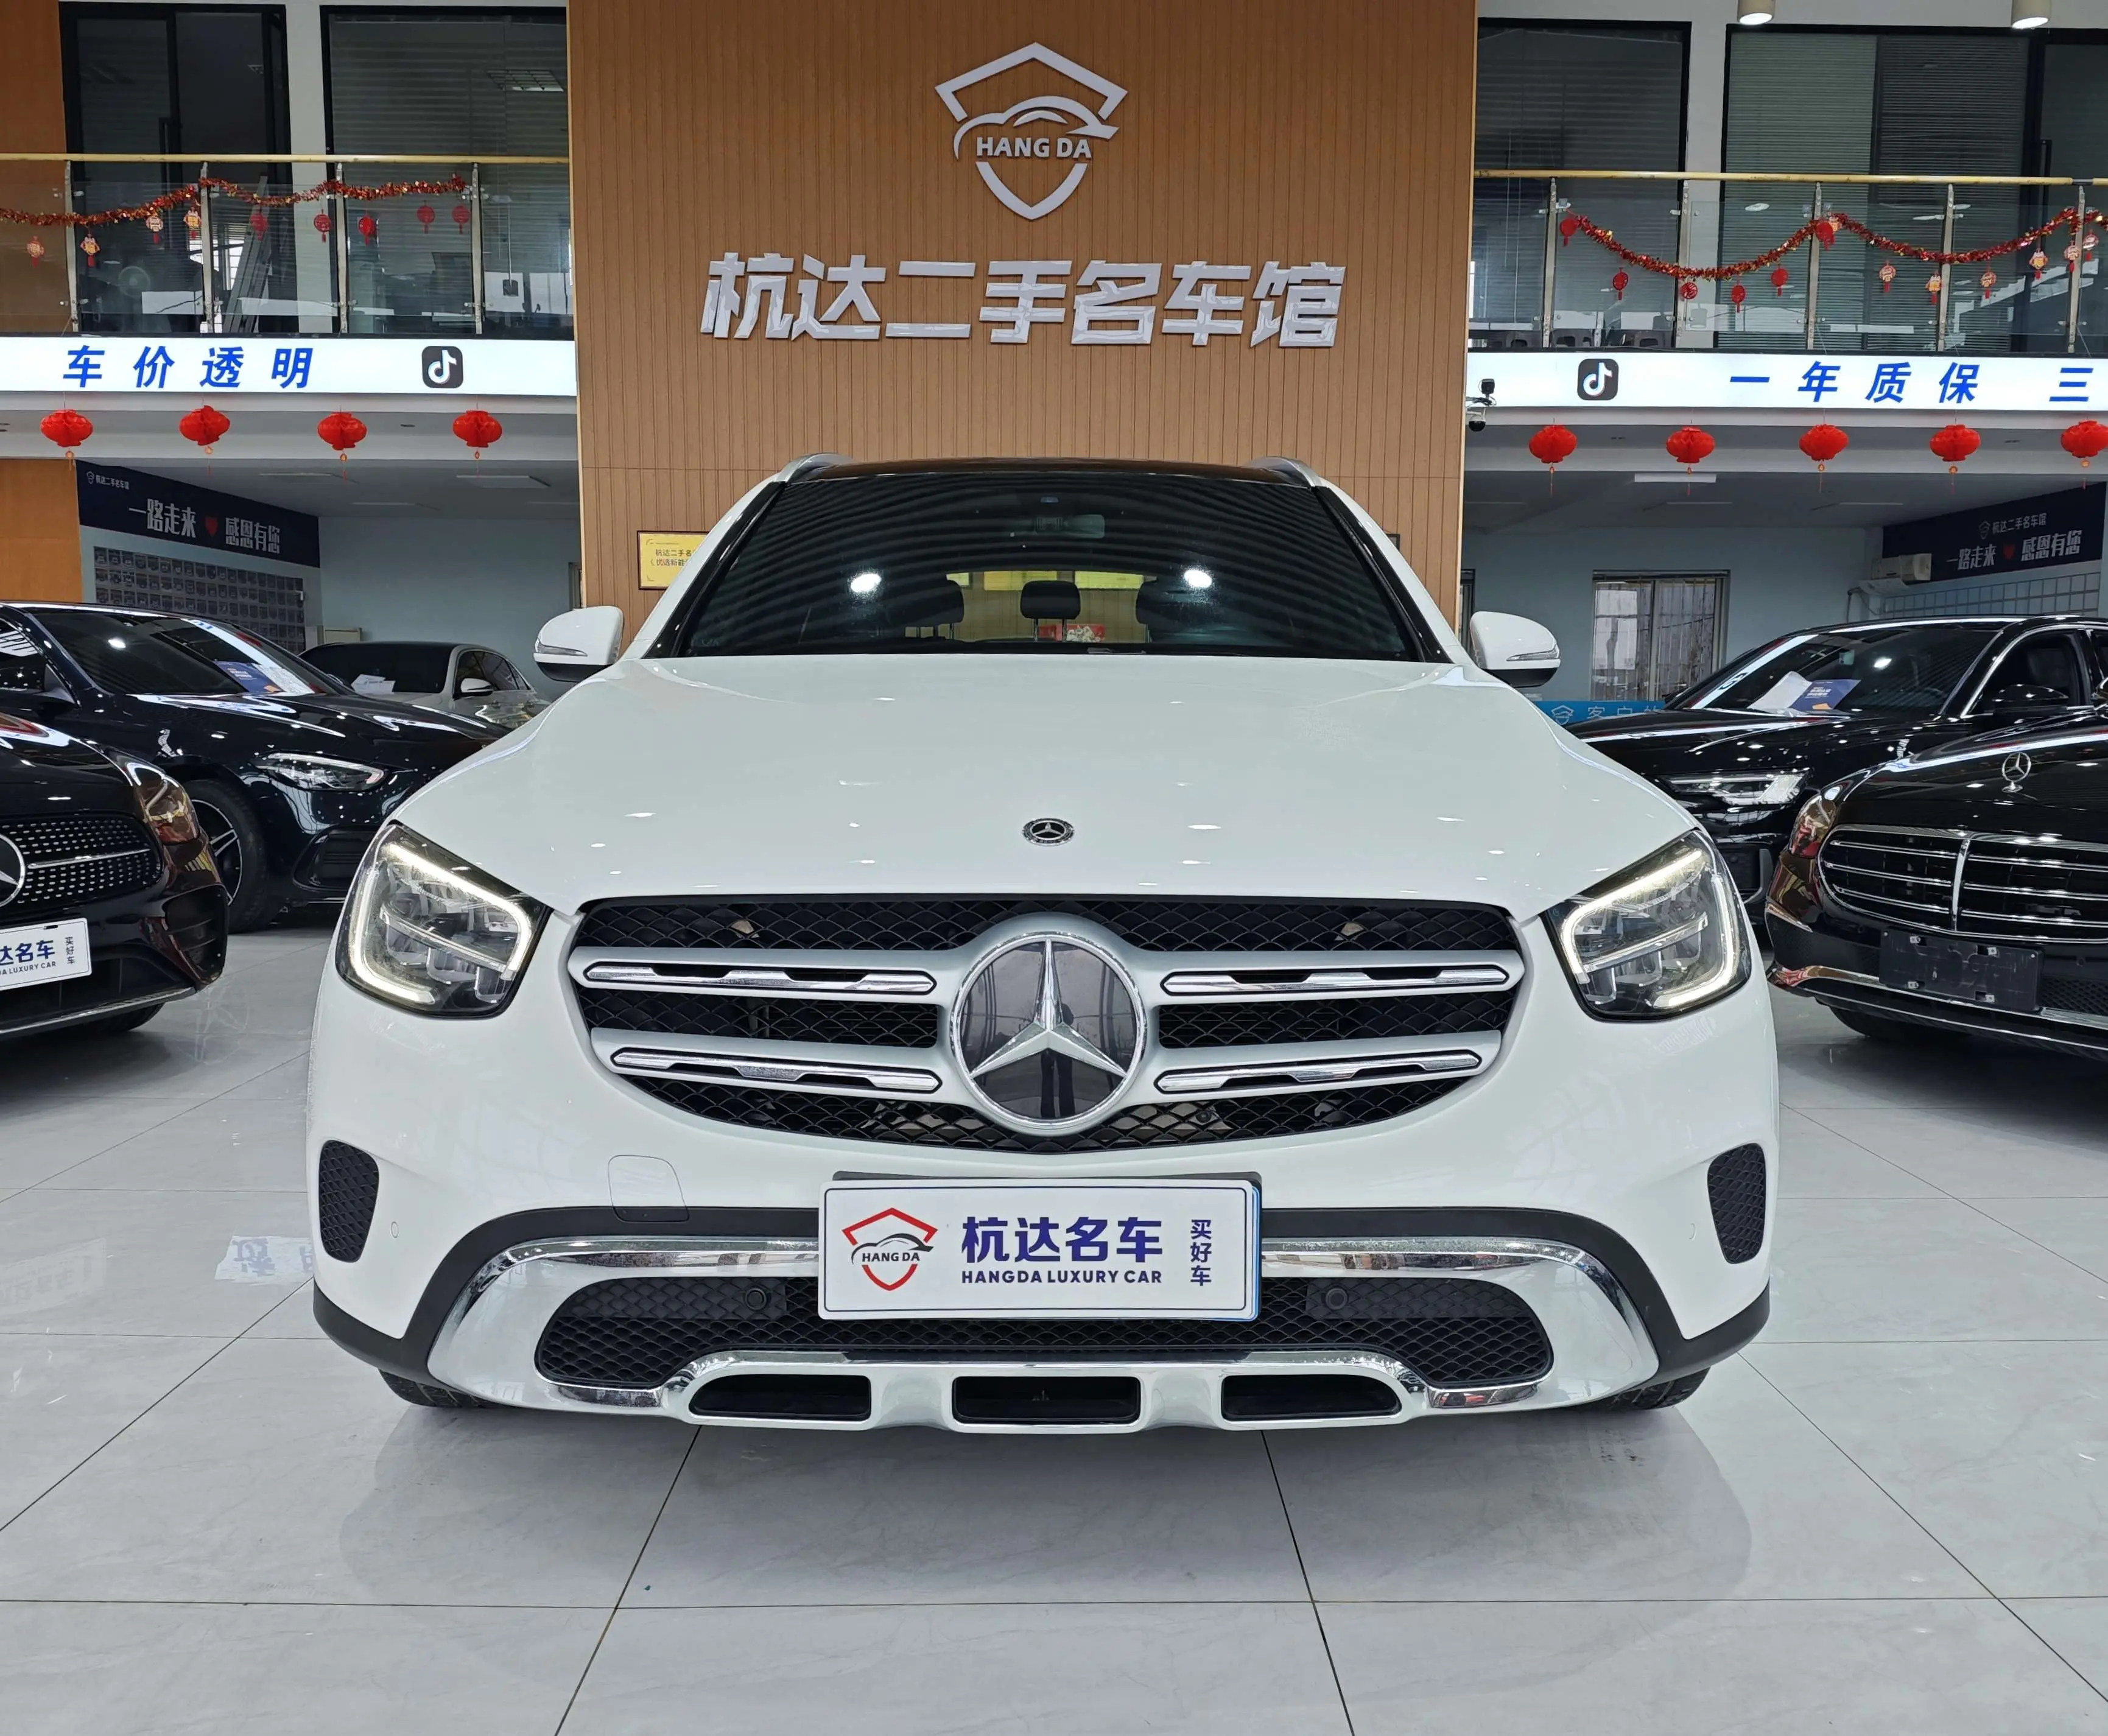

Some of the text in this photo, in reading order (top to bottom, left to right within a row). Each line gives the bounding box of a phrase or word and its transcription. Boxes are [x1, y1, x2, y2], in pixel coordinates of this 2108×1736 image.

[977, 137, 1092, 160] HANG DA
[700, 252, 1346, 348] 杭达二手名车馆
[63, 345, 312, 388] 车价透明
[1730, 360, 2093, 403] 一年质保 三
[128, 498, 280, 554] 一路走来 感恩有您
[1992, 512, 2048, 535] 杭达二手名车馆
[655, 549, 695, 557] 杭达二手名
[1946, 529, 2083, 571] 一路走来 感恩有您
[1586, 705, 1662, 720] 客户
[65, 936, 76, 965] 买好车
[9, 964, 39, 974] LUXURY
[961, 1216, 1164, 1264] 杭达名车
[1190, 1218, 1212, 1287] 买好车
[862, 1251, 921, 1263] HANG DA
[961, 1270, 1163, 1284] HANGDA LUXURY CAR
